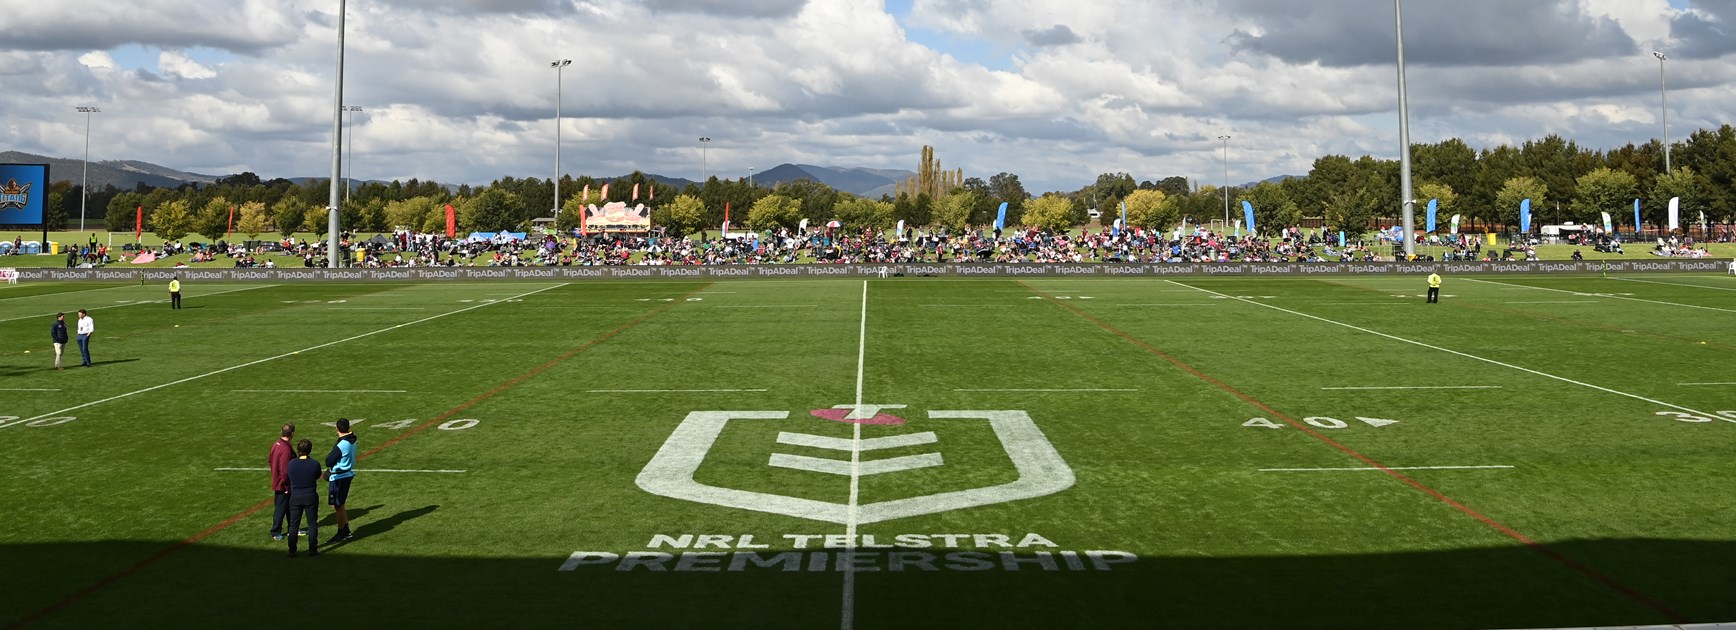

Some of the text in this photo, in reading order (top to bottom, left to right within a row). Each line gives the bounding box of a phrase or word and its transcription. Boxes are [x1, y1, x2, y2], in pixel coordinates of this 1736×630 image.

[50, 271, 87, 279] TripADeal
[95, 271, 132, 279] TripADeal
[185, 271, 222, 279] TripADeal
[230, 271, 268, 279] TripADeal
[277, 270, 315, 279] TripADeal
[323, 270, 361, 278] TripADeal
[369, 270, 409, 278] TripADeal
[418, 270, 457, 278] TripADeal
[466, 269, 505, 278] TripADeal
[514, 269, 553, 277] TripADeal
[562, 269, 601, 277] TripADeal
[610, 268, 650, 277] TripADeal
[659, 268, 699, 276] TripADeal
[708, 267, 748, 276] TripADeal
[757, 267, 798, 275] TripADeal
[807, 266, 847, 275] TripADeal
[906, 266, 946, 274] TripADeal
[955, 266, 995, 274] TripADeal
[1004, 266, 1045, 274] TripADeal
[1054, 266, 1094, 274] TripADeal
[1103, 266, 1143, 274] TripADeal
[1152, 265, 1192, 274] TripADeal
[1201, 265, 1241, 274] TripADeal
[1250, 265, 1290, 273] TripADeal
[1299, 265, 1338, 273] TripADeal
[1347, 265, 1386, 273] TripADeal
[1395, 265, 1434, 273] TripADeal
[1443, 264, 1481, 273] TripADeal
[1490, 264, 1528, 272] TripADeal
[1536, 263, 1576, 272] TripADeal
[1632, 262, 1670, 271] TripADeal
[1678, 262, 1716, 270] TripADeal
[371, 418, 480, 430] 40
[1241, 416, 1348, 429] 40
[647, 533, 1059, 548] NRL TELSTRA
[558, 550, 1138, 571] PREMIERSHIP
